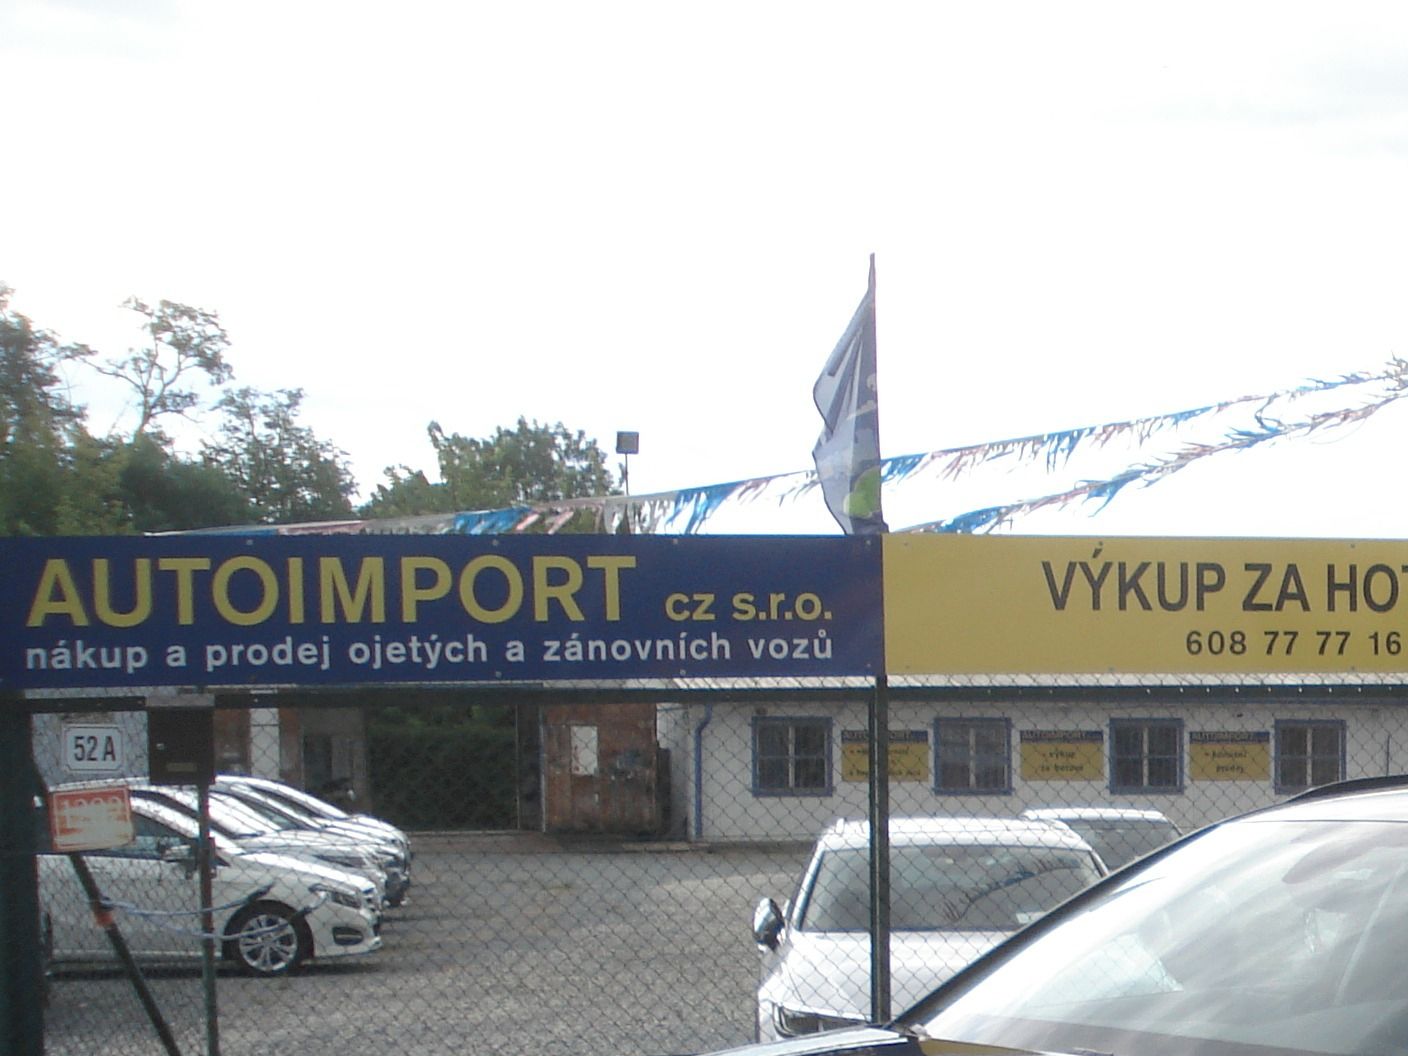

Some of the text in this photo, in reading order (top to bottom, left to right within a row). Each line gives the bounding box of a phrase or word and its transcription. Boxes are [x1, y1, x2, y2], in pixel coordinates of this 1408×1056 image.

[26, 554, 833, 627] AUTOIMPORT cz s.r.o.
[1041, 548, 1227, 612] VÝKUP
[1242, 563, 1311, 613] ZA
[26, 629, 833, 674] nákup a prodej ojetých a zánovních vozů
[1186, 630, 1403, 656] 608 77 77 16
[74, 735, 116, 762] 52 A
